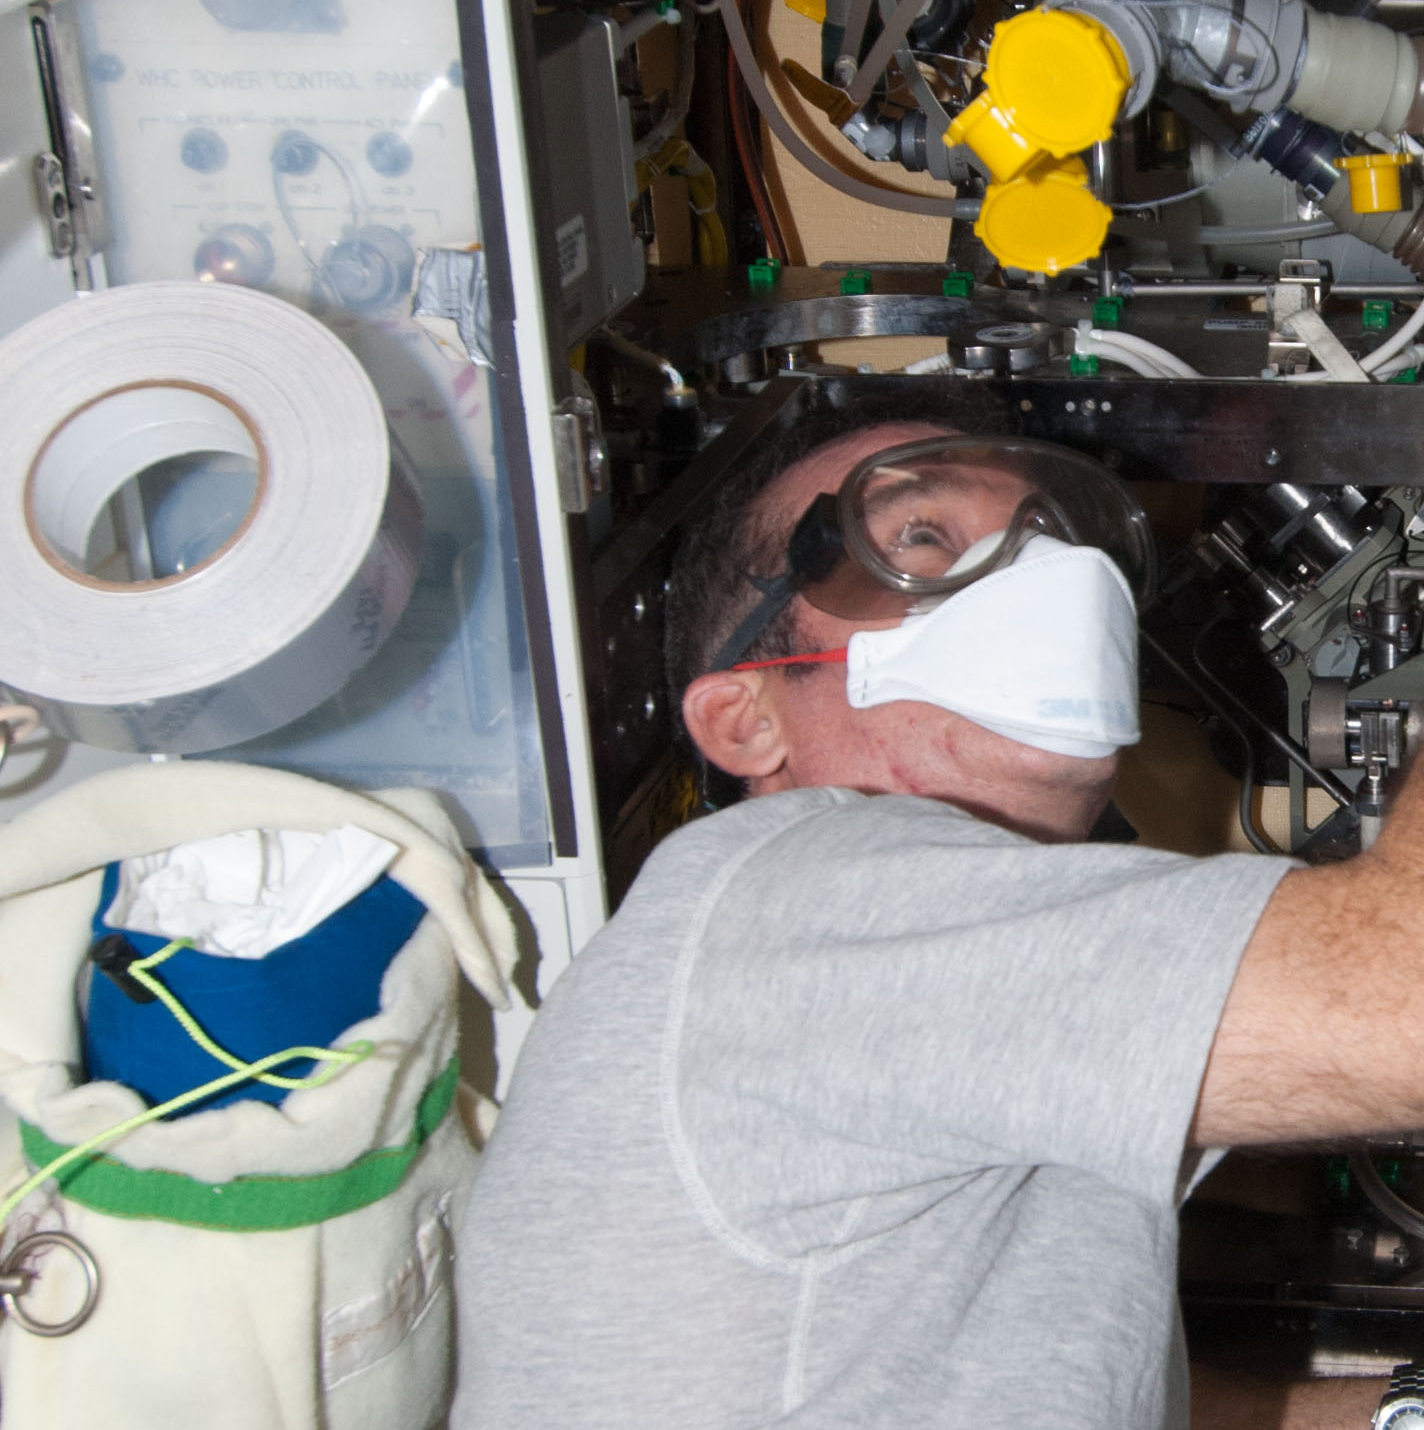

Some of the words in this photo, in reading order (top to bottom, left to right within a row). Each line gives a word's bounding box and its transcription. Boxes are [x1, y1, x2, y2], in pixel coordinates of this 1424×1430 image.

[136, 70, 181, 88] WHC
[192, 71, 262, 89] POWER
[272, 71, 364, 89] CONTROL
[375, 72, 433, 90] PANE
